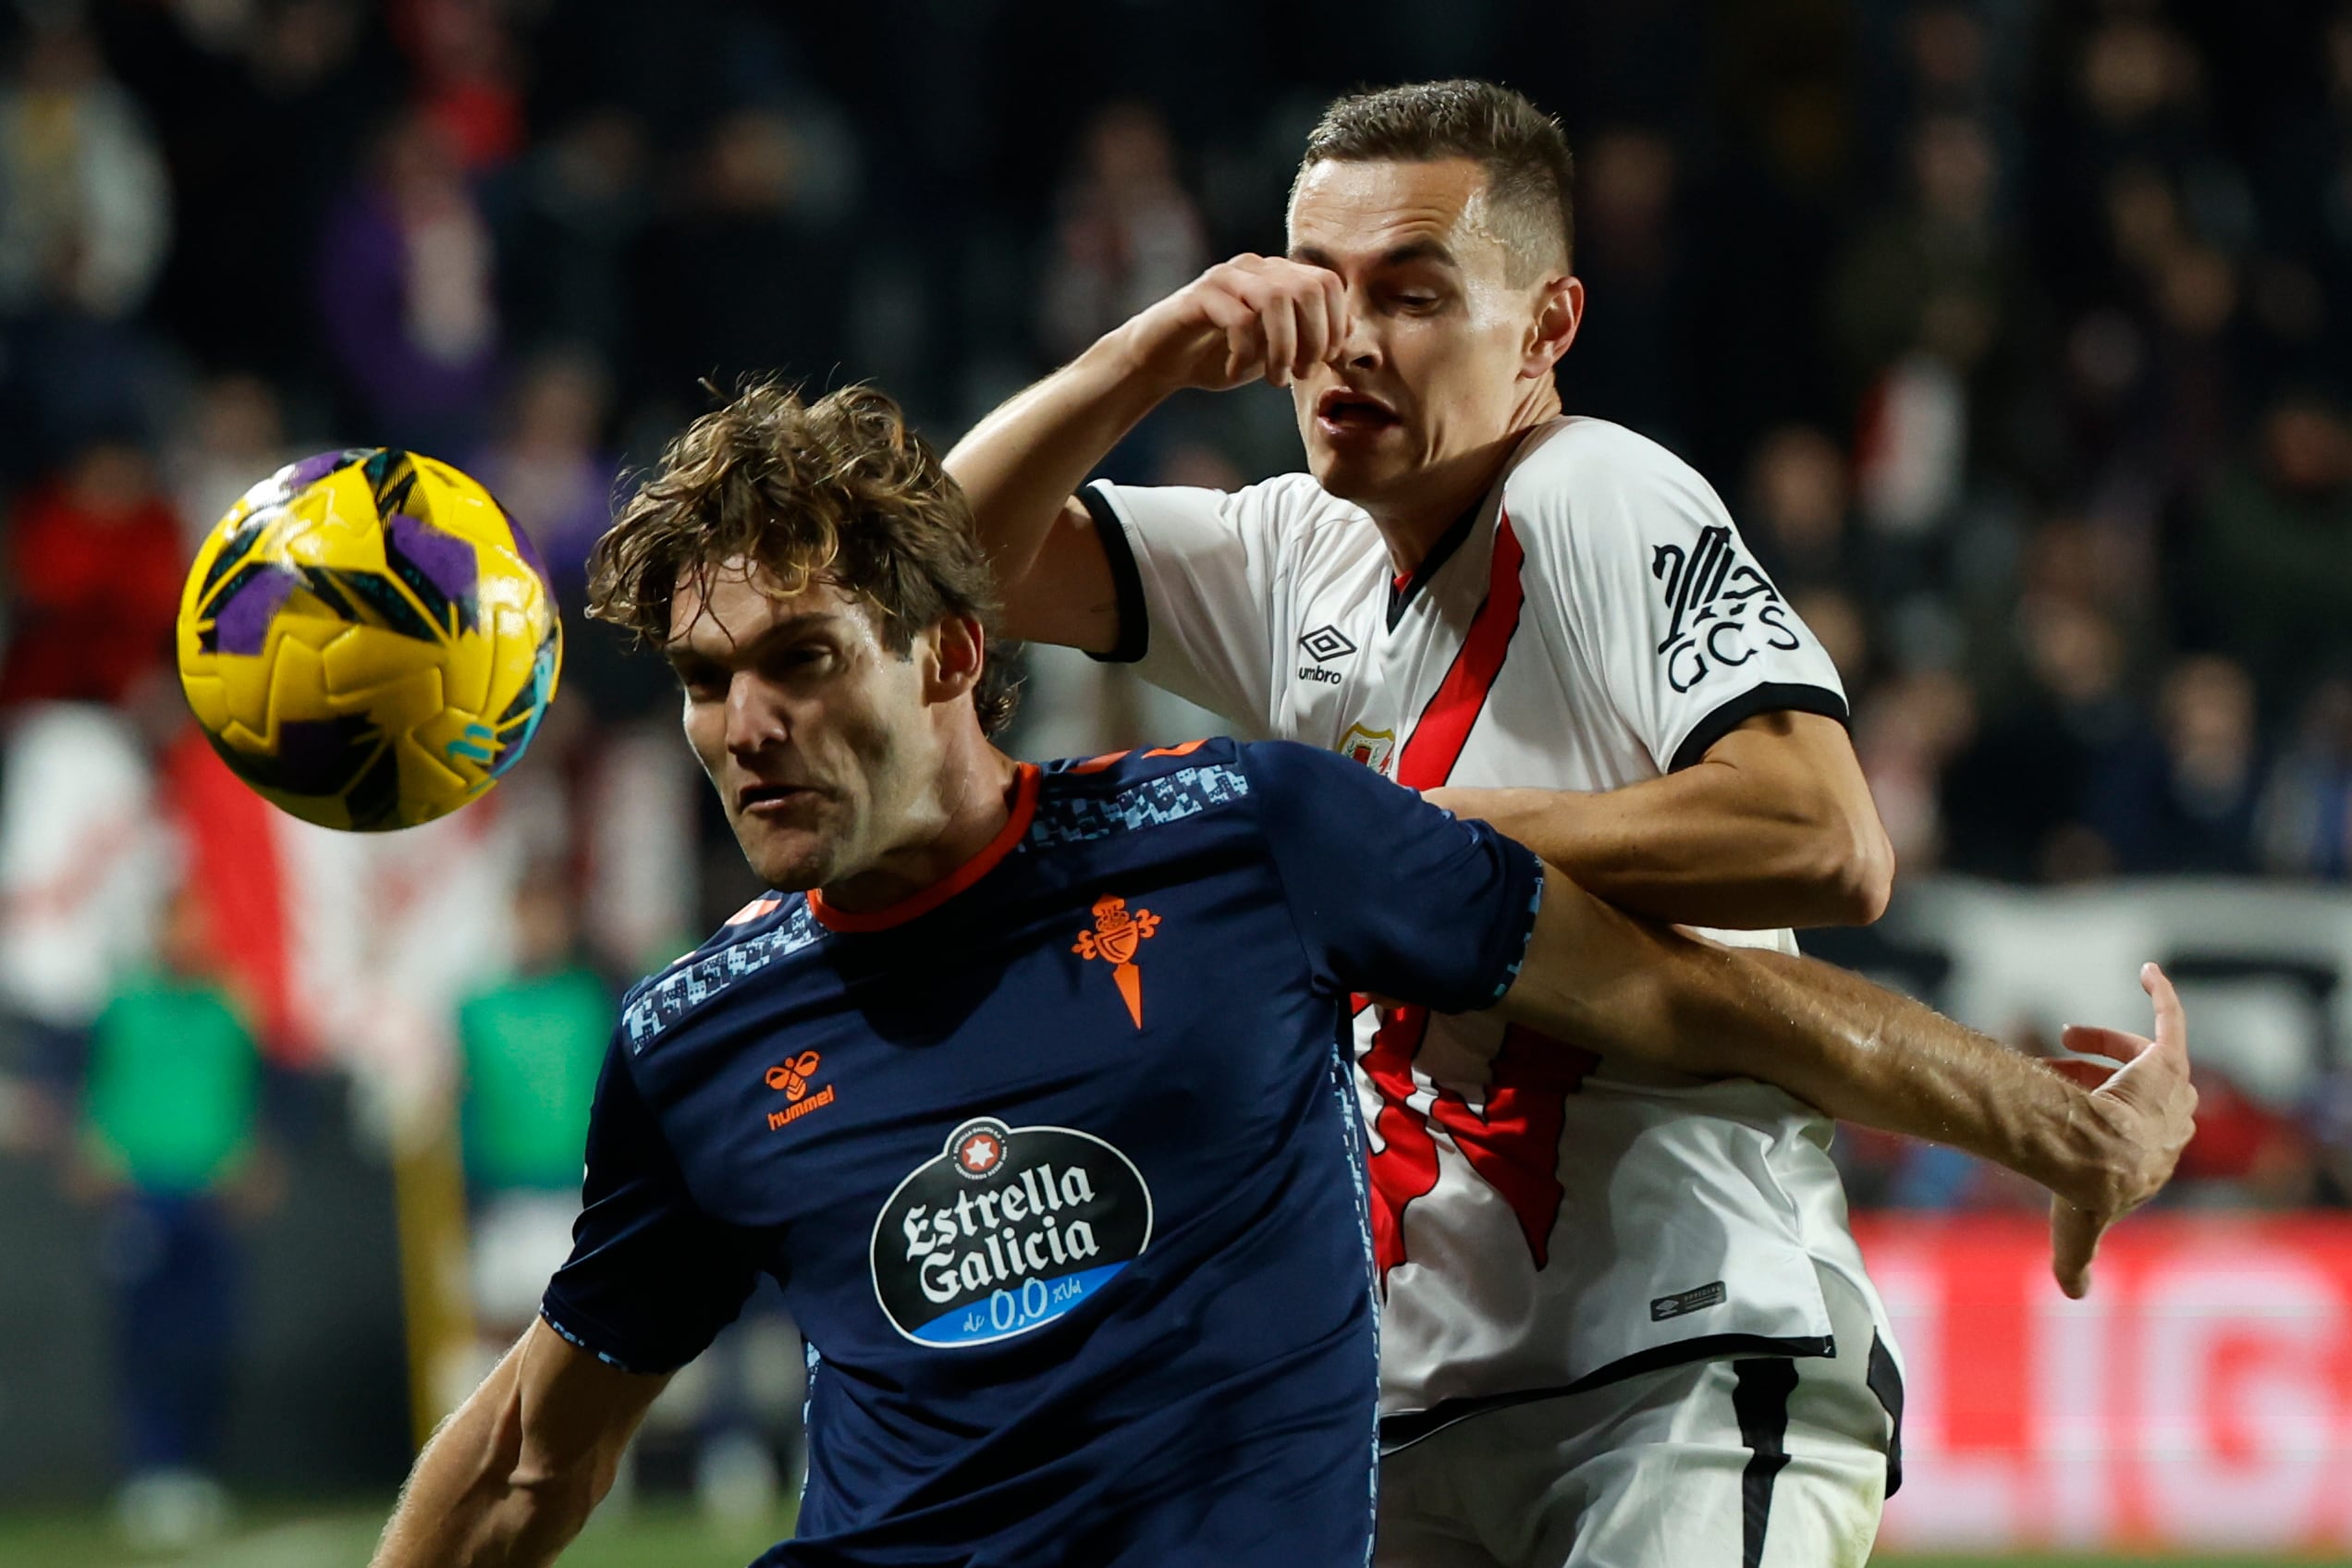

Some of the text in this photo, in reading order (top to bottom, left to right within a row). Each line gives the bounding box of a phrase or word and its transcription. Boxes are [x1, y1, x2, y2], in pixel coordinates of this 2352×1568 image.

[1298, 665, 1342, 685] umbro
[767, 1084, 835, 1131] hummel
[902, 1163, 1096, 1262] Estrella
[920, 1219, 1100, 1304] Galicia
[989, 1276, 1048, 1331] 0,0
[1871, 1250, 2352, 1542] LIG
